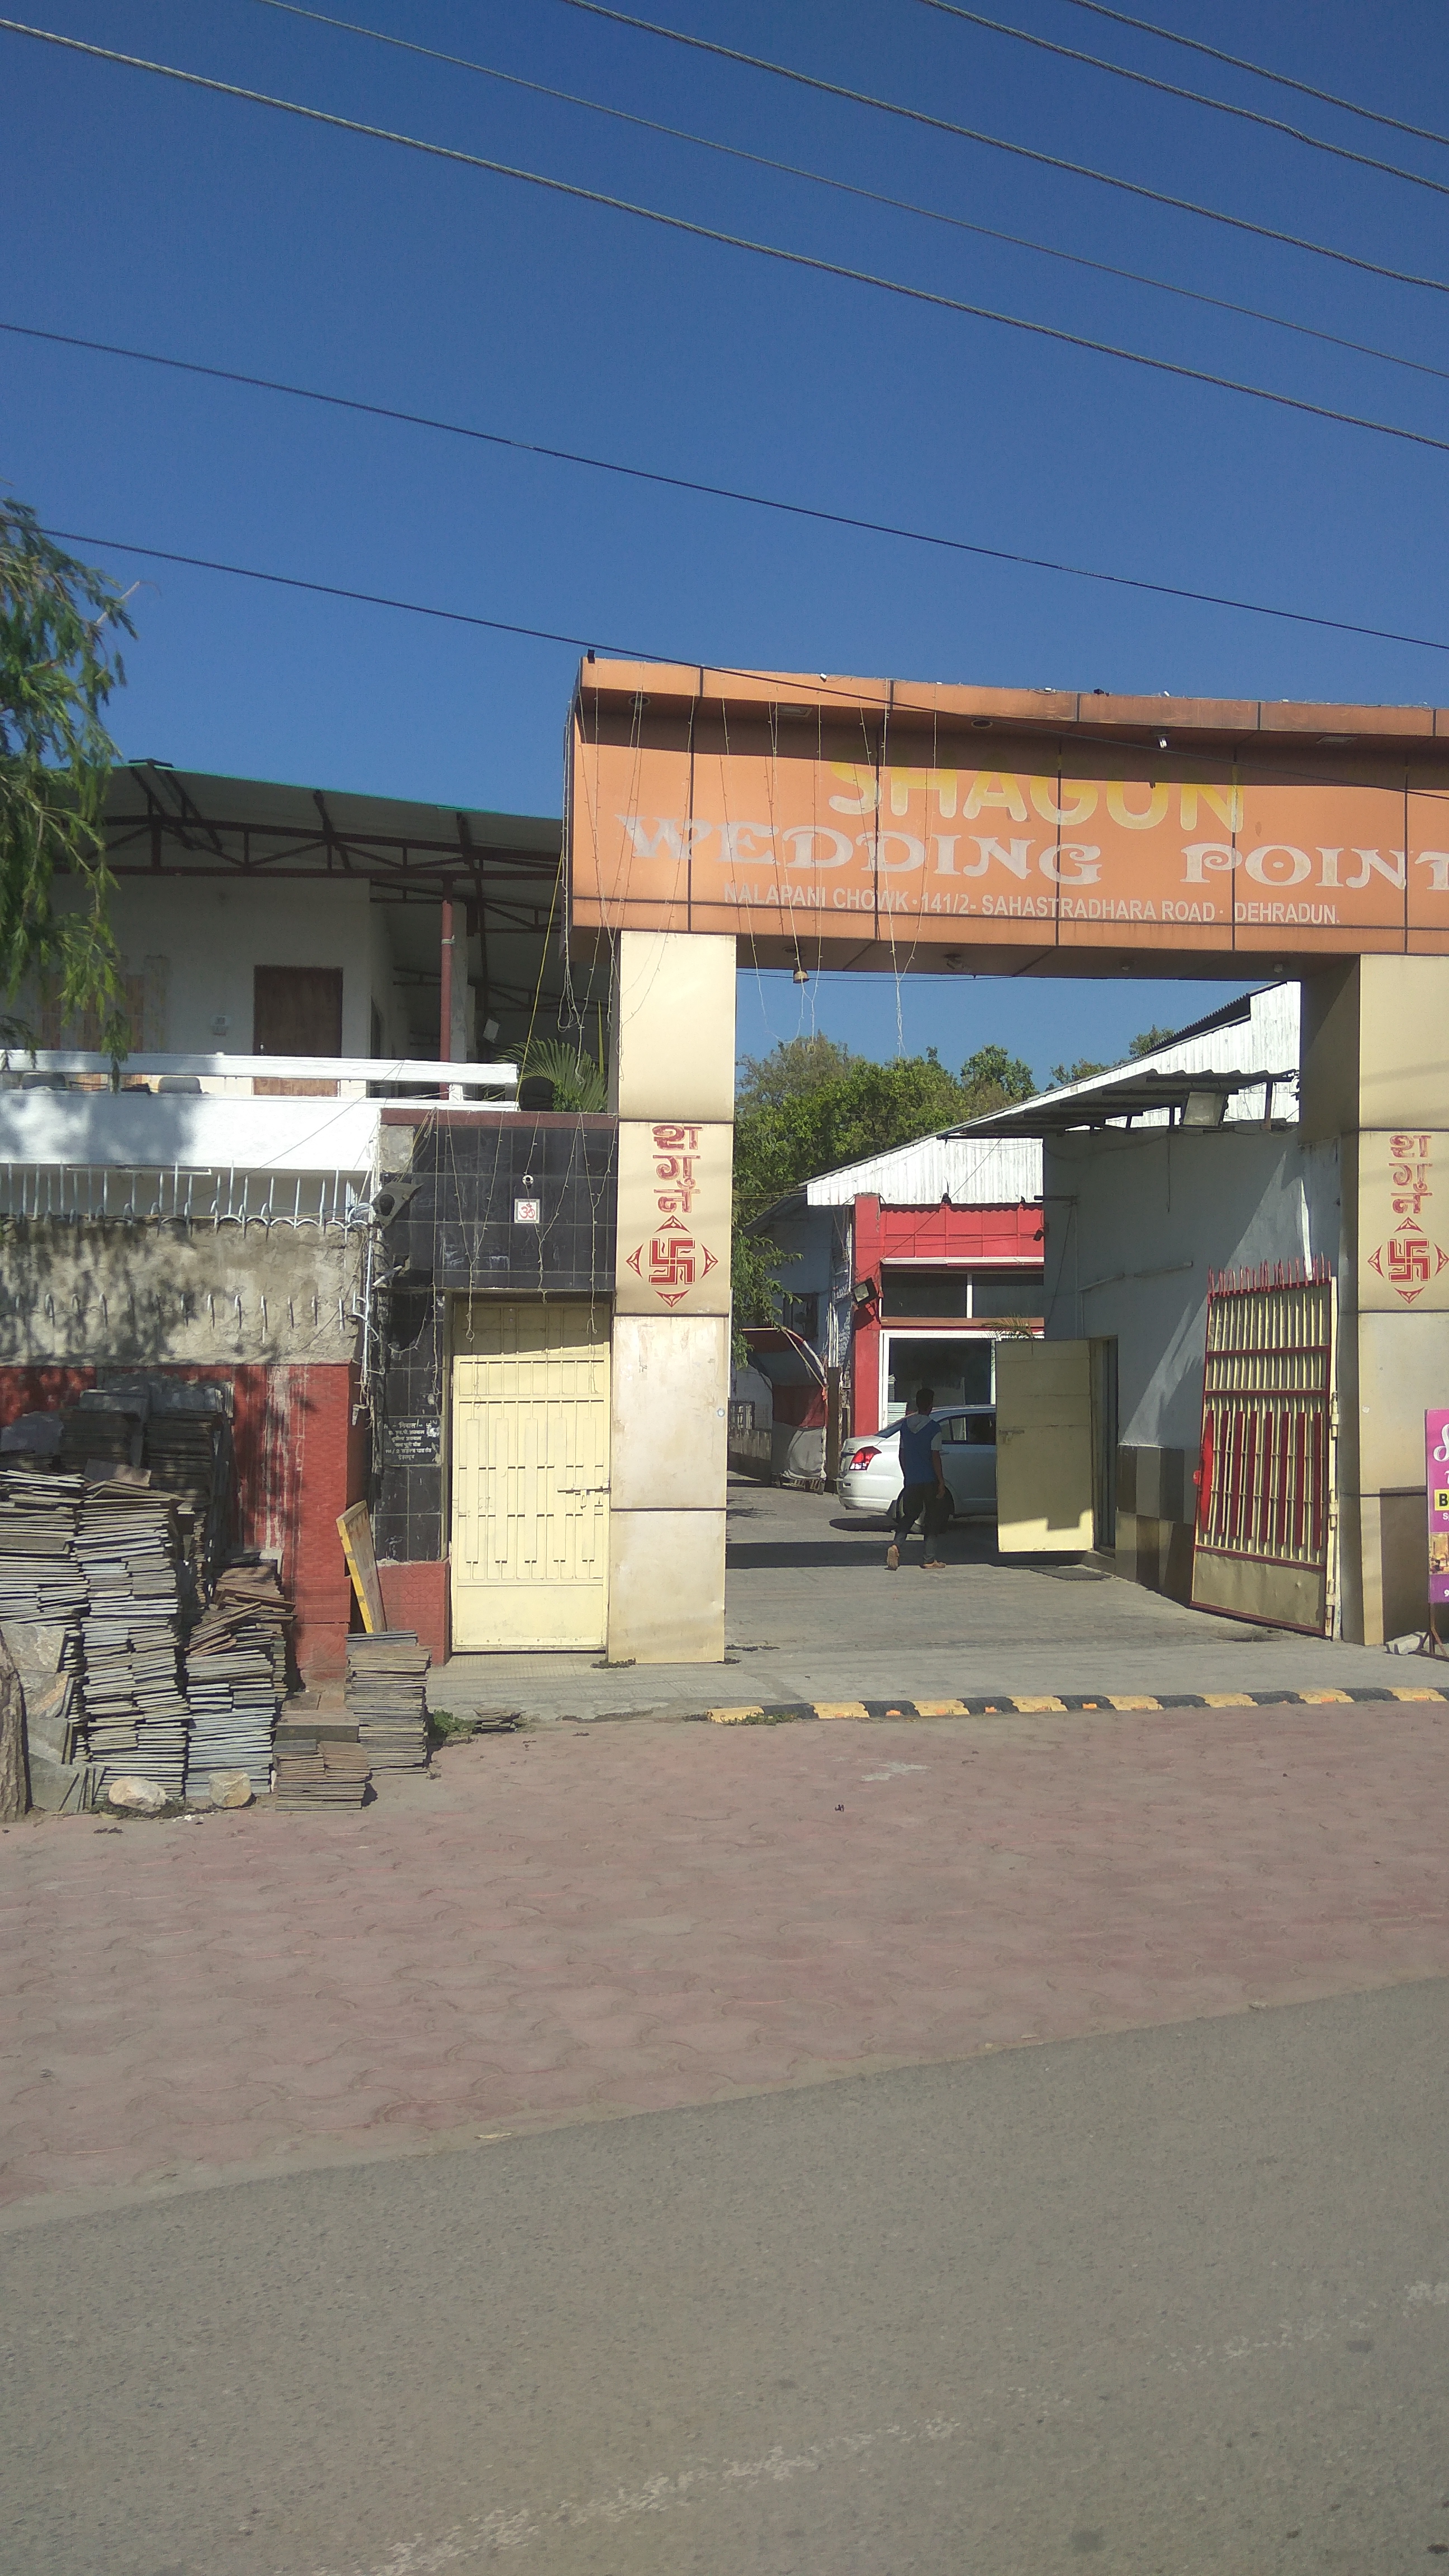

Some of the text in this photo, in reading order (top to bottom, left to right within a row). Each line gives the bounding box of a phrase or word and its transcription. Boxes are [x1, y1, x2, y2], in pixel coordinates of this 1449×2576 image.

[828, 746, 1244, 833] SHAGUN
[615, 813, 1449, 891] WEDDING POINT
[723, 882, 826, 908] NALAPANI
[833, 888, 909, 911] CHOWK
[981, 895, 1157, 920] SAHASTRADHARA
[1161, 900, 1215, 922] ROAD
